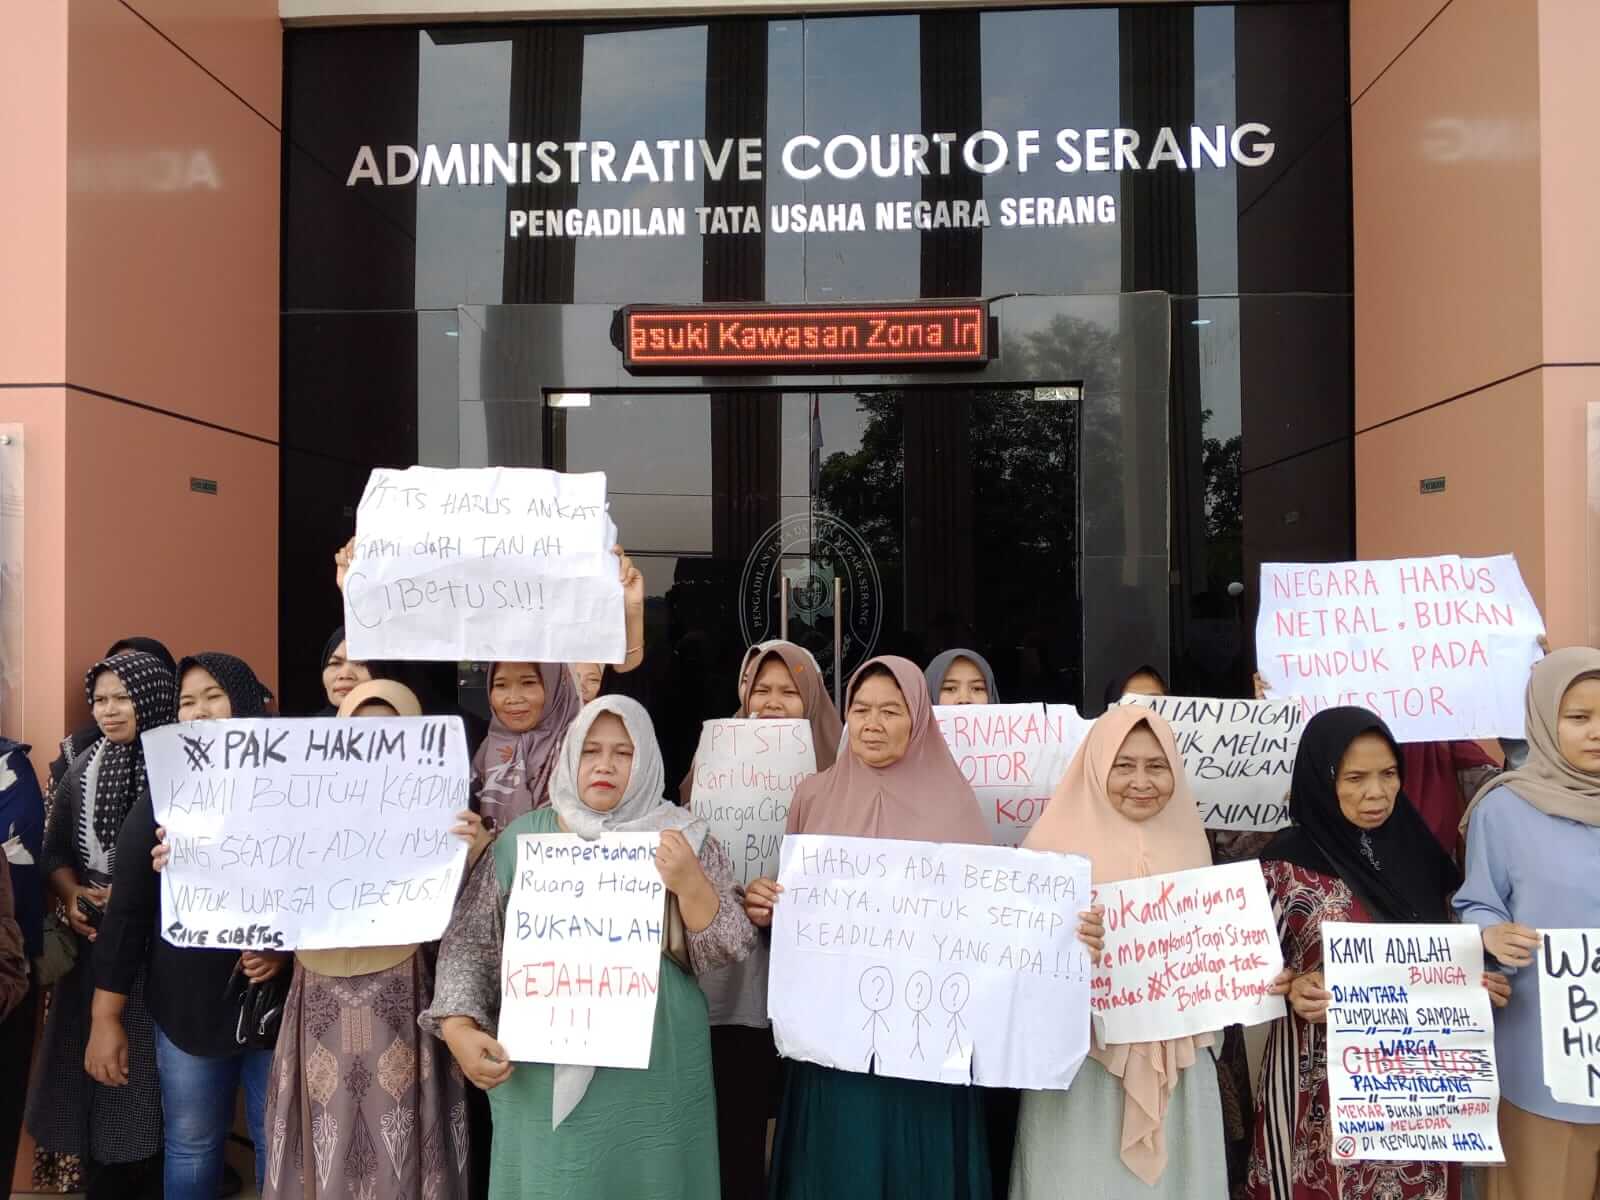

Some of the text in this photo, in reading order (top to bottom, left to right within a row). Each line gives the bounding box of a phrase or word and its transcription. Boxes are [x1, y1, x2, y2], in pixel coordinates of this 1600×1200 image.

[346, 122, 1276, 187] ADMINISTRATIVE COURT OF SERANG
[510, 195, 1116, 239] PENGADILAN TATA USAHA NEGARA SERANG
[632, 322, 708, 350] asuki
[719, 322, 857, 351] Kawasan
[867, 318, 942, 348] Zona
[440, 492, 513, 515] HARUS
[526, 497, 601, 520] ANKAT
[1273, 562, 1497, 599] NEGARA HARUS
[1414, 599, 1514, 629] BUKAN
[1278, 639, 1489, 679] TUNDUK PADA
[223, 727, 290, 770] PAK
[305, 726, 405, 763] HAKIM
[711, 724, 807, 755] PT STS
[697, 762, 734, 791] Cari
[958, 751, 1032, 785] OTOR
[1195, 756, 1293, 780] BUKAN
[167, 776, 237, 818] KAMI
[249, 771, 368, 816] BUTUH
[694, 799, 754, 831] Warga
[996, 797, 1051, 825] KOT
[525, 840, 658, 865] Mempertahank
[744, 833, 784, 861] BUN
[520, 869, 663, 900] Ruang Hidup
[800, 845, 1077, 902] HARUS ADA BEBERAPA
[239, 884, 315, 915] WARGA
[892, 898, 969, 921] UNTUK
[515, 909, 662, 945] BUKANLAH
[796, 919, 916, 952] KEADILAN
[932, 933, 988, 963] YANG
[1329, 935, 1452, 964] KAMI ADALAH
[504, 958, 660, 1000] KEJAHATAN
[1408, 965, 1468, 986] BUNGA
[1091, 986, 1144, 1012] enindas
[1328, 1006, 1478, 1027] TUMPUKAN SAMPAH.
[1379, 1039, 1438, 1058] WARGA
[1349, 1074, 1473, 1094] PADARINCANG
[1336, 1102, 1490, 1120] MEKAR BUKAN UNTUK ABADI
[1338, 1116, 1452, 1134] NAMUN MELEDAK
[1362, 1131, 1494, 1152] DI KEMUDIAN HARI.
